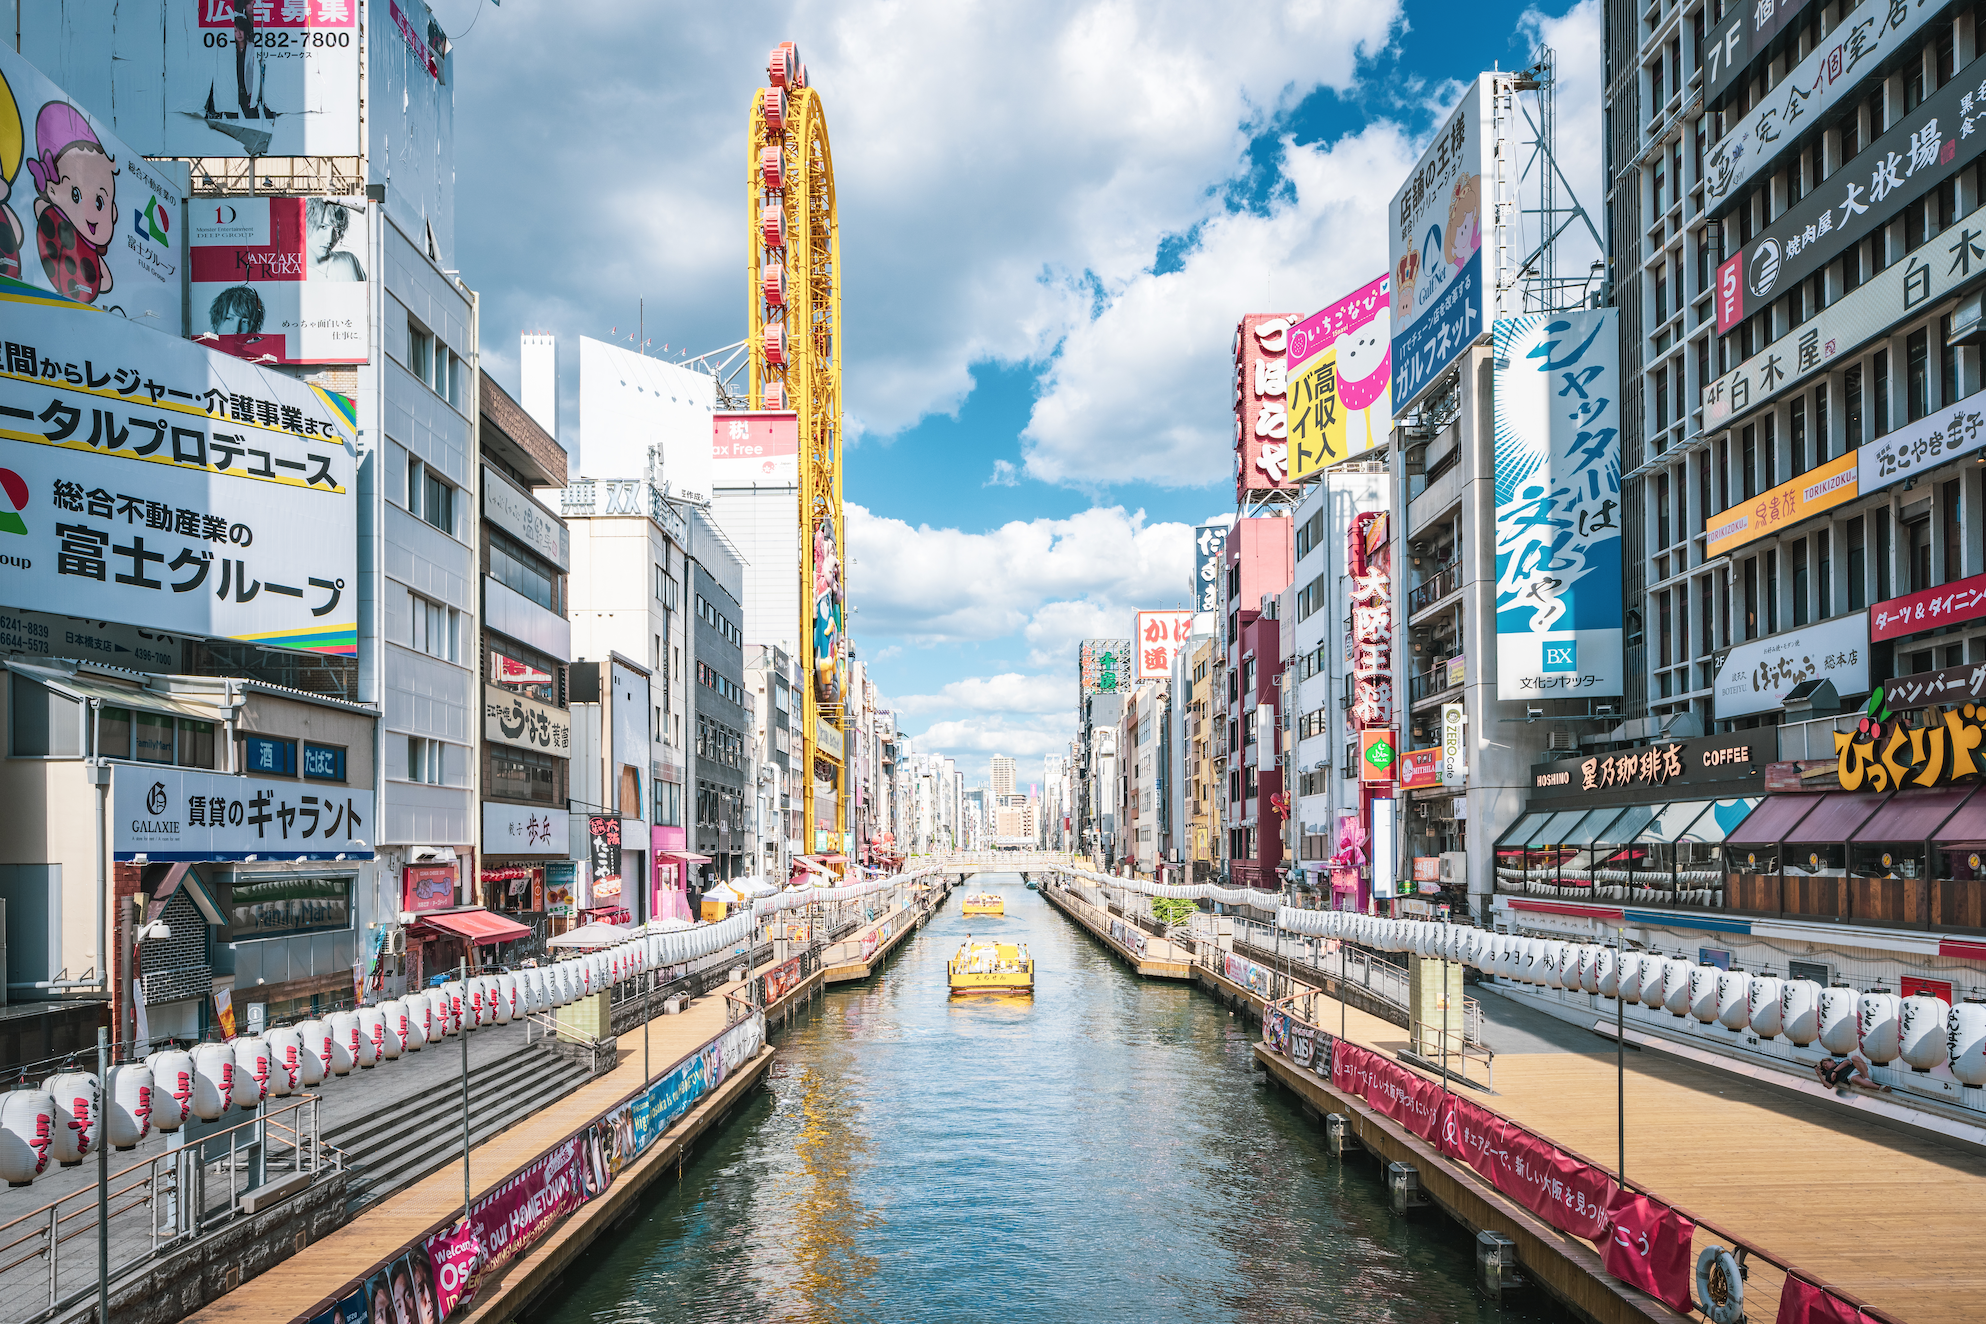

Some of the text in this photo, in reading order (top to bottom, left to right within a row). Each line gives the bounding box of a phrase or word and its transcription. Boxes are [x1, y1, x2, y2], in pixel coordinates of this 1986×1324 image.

[203, 32, 350, 48] 06-282-7800
[1708, 18, 1741, 84] 7F
[1400, 111, 1465, 229] 店舗の王様
[1785, 118, 1943, 262] 焼肉屋 大牧場
[127, 234, 176, 275] 富士グループ
[235, 251, 302, 269] KANZAKI
[261, 262, 302, 279] RUKA
[1307, 288, 1378, 342] いちごなび
[1396, 297, 1477, 404] ガルフネット
[1707, 327, 1821, 414] 4F 白木屋
[0, 338, 335, 440] 間からレジャー・介護事業まで
[1291, 372, 1313, 474] バイト
[1879, 411, 1984, 477] たこやき王子
[733, 443, 763, 455] Free
[1804, 471, 1852, 500] TORIKIZOKU
[53, 478, 253, 548] 総合不動産業の
[1707, 520, 1744, 543] TORIKIZOKU
[55, 522, 346, 618] 富士グループ
[1876, 588, 1986, 631] ダーツ&ダイニン
[66, 631, 112, 653] 日本橋支店
[1348, 565, 1393, 724] 大阪王将
[1546, 648, 1572, 666] BX
[1824, 649, 1858, 671] 総本店
[259, 741, 273, 768] 酒
[304, 748, 334, 775] たばこ
[1413, 764, 1436, 775] MITHILA
[1446, 726, 1457, 779] ZERO Cafe
[1536, 743, 1750, 792] HOSHINO 星乃珈琲店 COFFEE
[1833, 702, 1986, 793] びっくりド
[132, 819, 180, 834] GALAXIE
[188, 789, 362, 840] 賃貸のギャラント
[490, 1222, 508, 1252] our
